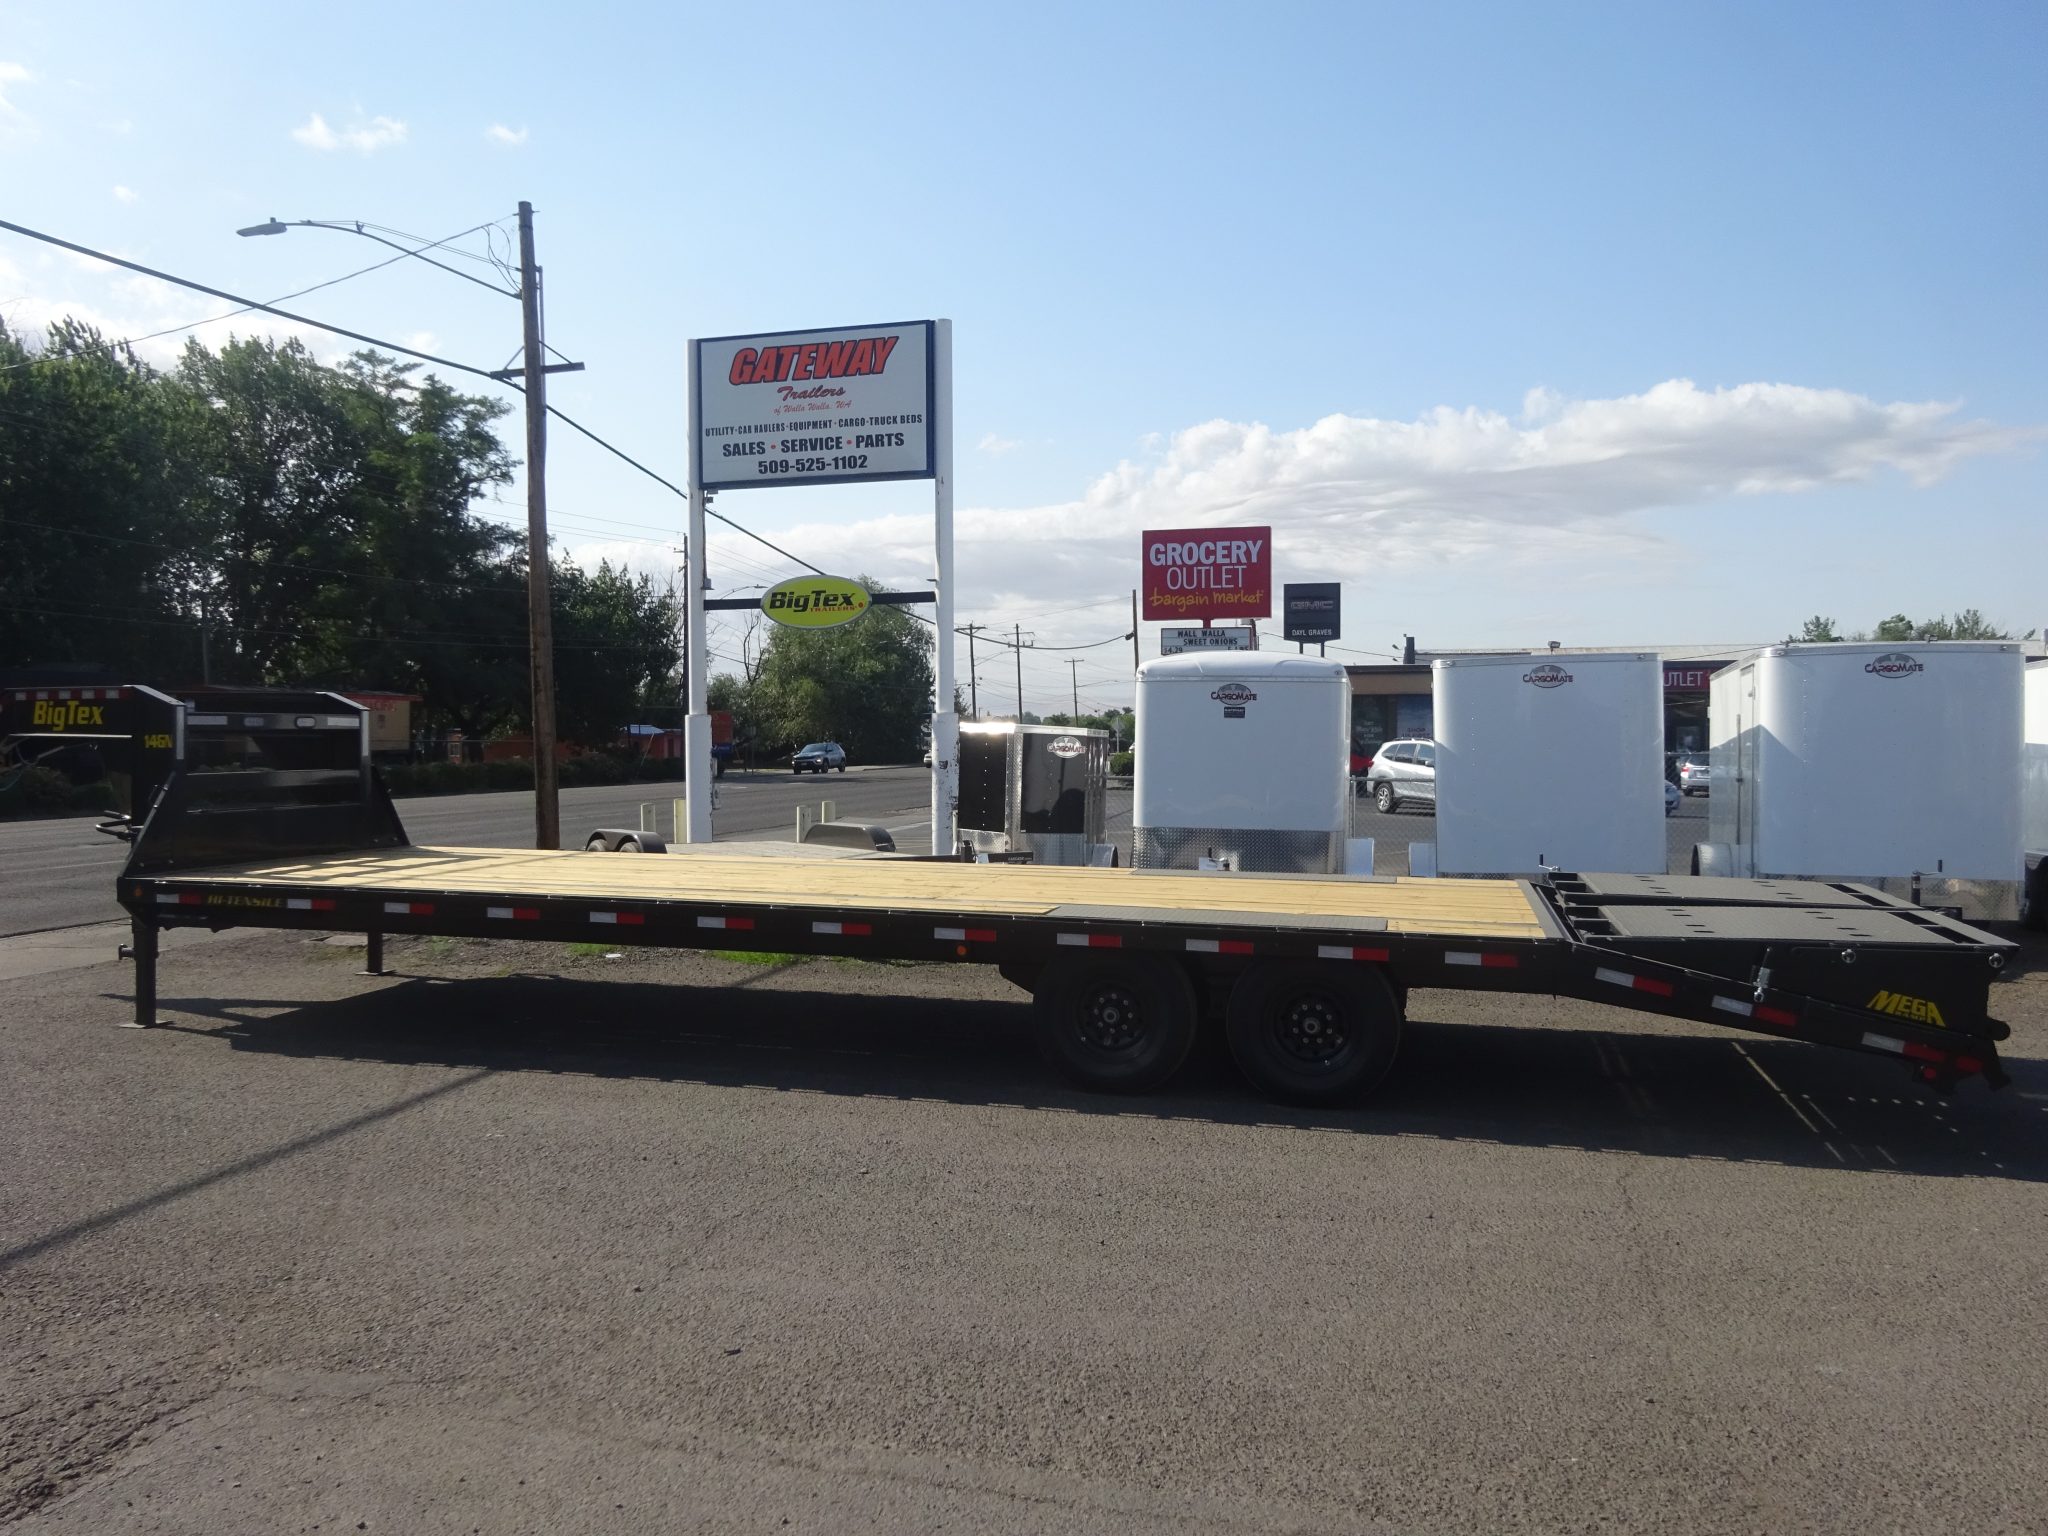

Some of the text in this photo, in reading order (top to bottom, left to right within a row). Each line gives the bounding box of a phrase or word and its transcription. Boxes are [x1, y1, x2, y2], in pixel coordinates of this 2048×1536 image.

[729, 336, 899, 385] GATEWAY
[777, 384, 846, 401] Trailers
[774, 407, 781, 415] of
[784, 404, 805, 413] Walla
[835, 400, 852, 408] WA
[900, 414, 922, 424] BEDS
[722, 432, 905, 457] SALES SERVICE PARTS
[758, 454, 868, 474] 509-525-1102
[1149, 540, 1262, 566] GROCERY
[1166, 565, 1247, 590] OUTLET
[769, 589, 855, 612] BigTex
[1149, 586, 1261, 612] bargain market
[1177, 629, 1226, 638] WALL WALLA
[1209, 638, 1238, 646] ONIONS
[1308, 628, 1332, 636] GRAVES
[33, 701, 104, 731] BigTex
[1866, 990, 1946, 1027] MEGA
